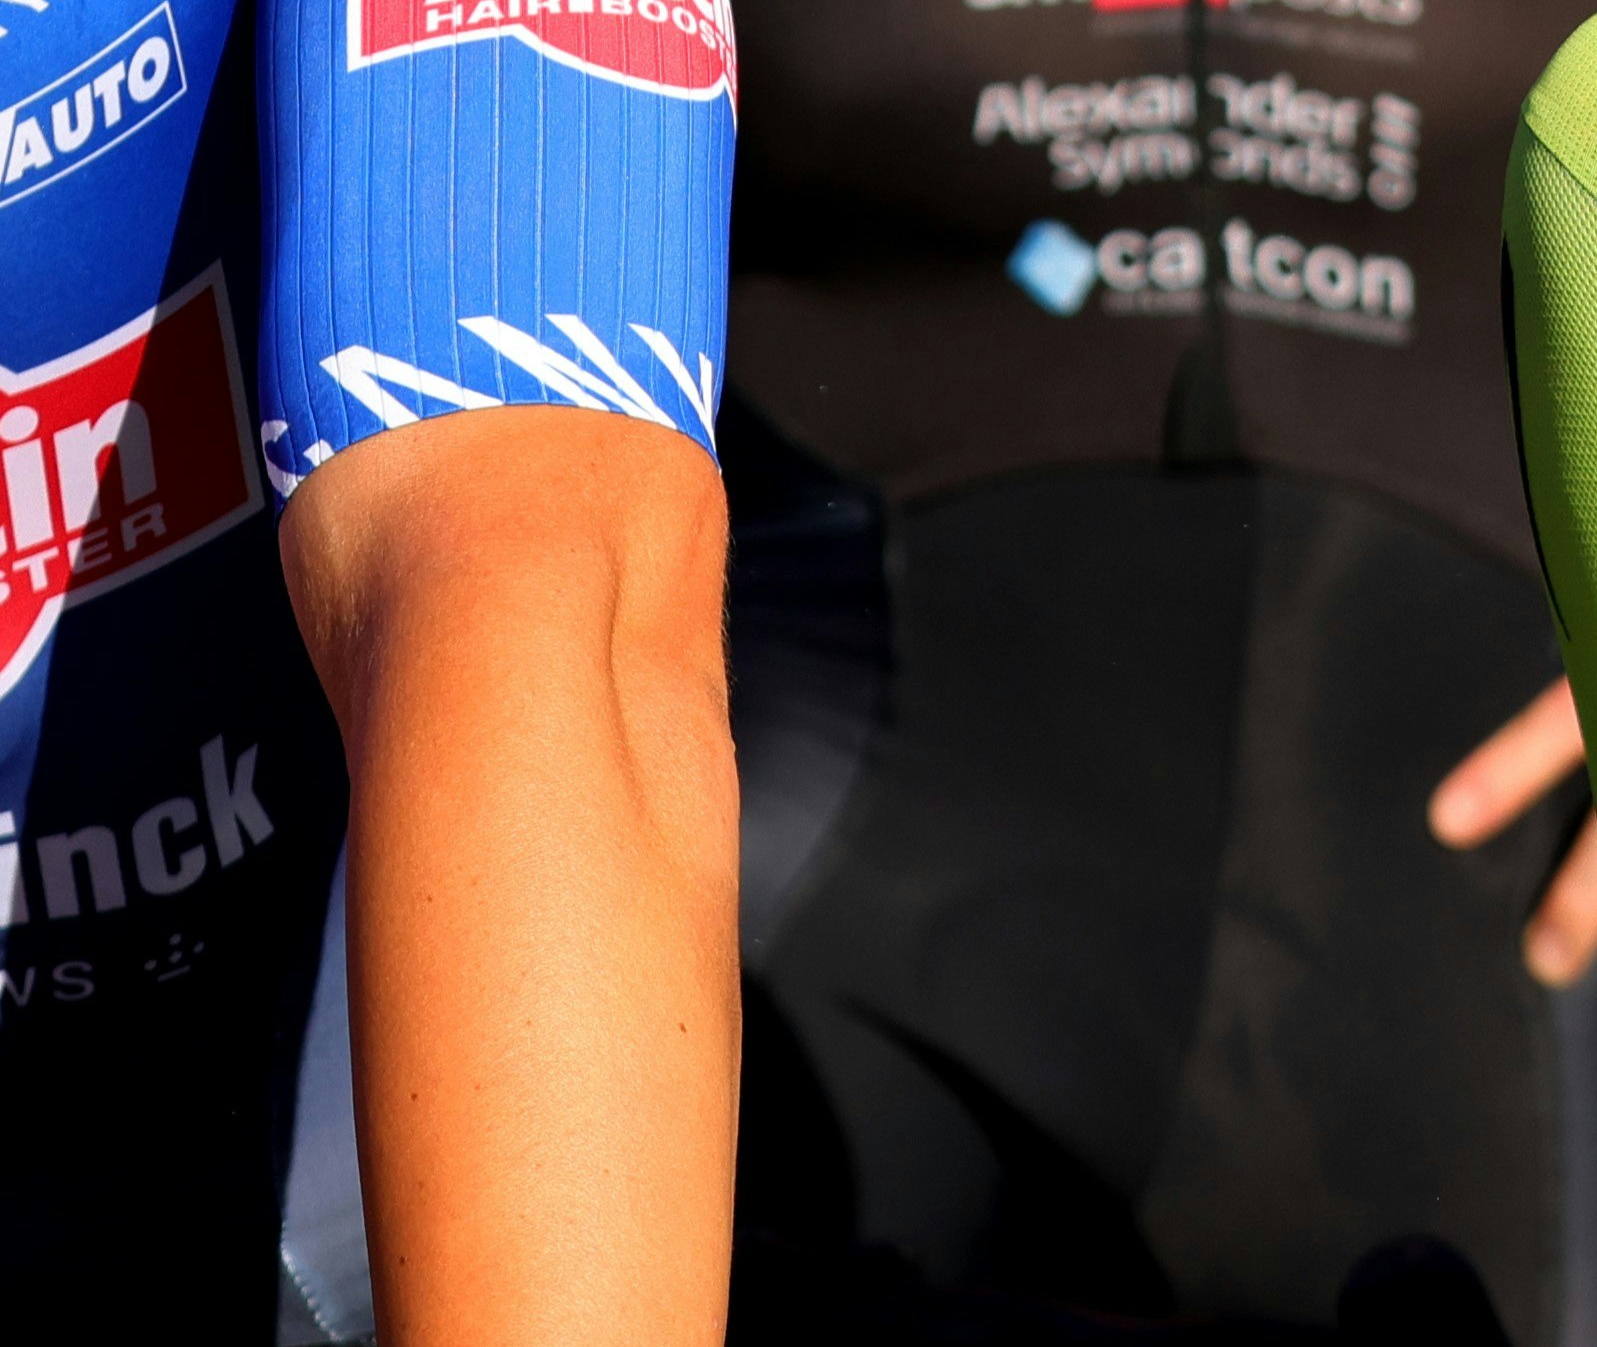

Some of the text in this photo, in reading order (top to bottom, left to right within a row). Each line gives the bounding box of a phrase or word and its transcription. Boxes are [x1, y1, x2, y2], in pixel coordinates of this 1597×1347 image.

[4, 36, 171, 185] AUTO
[1096, 217, 1416, 320] catcon
[0, 398, 157, 554] in
